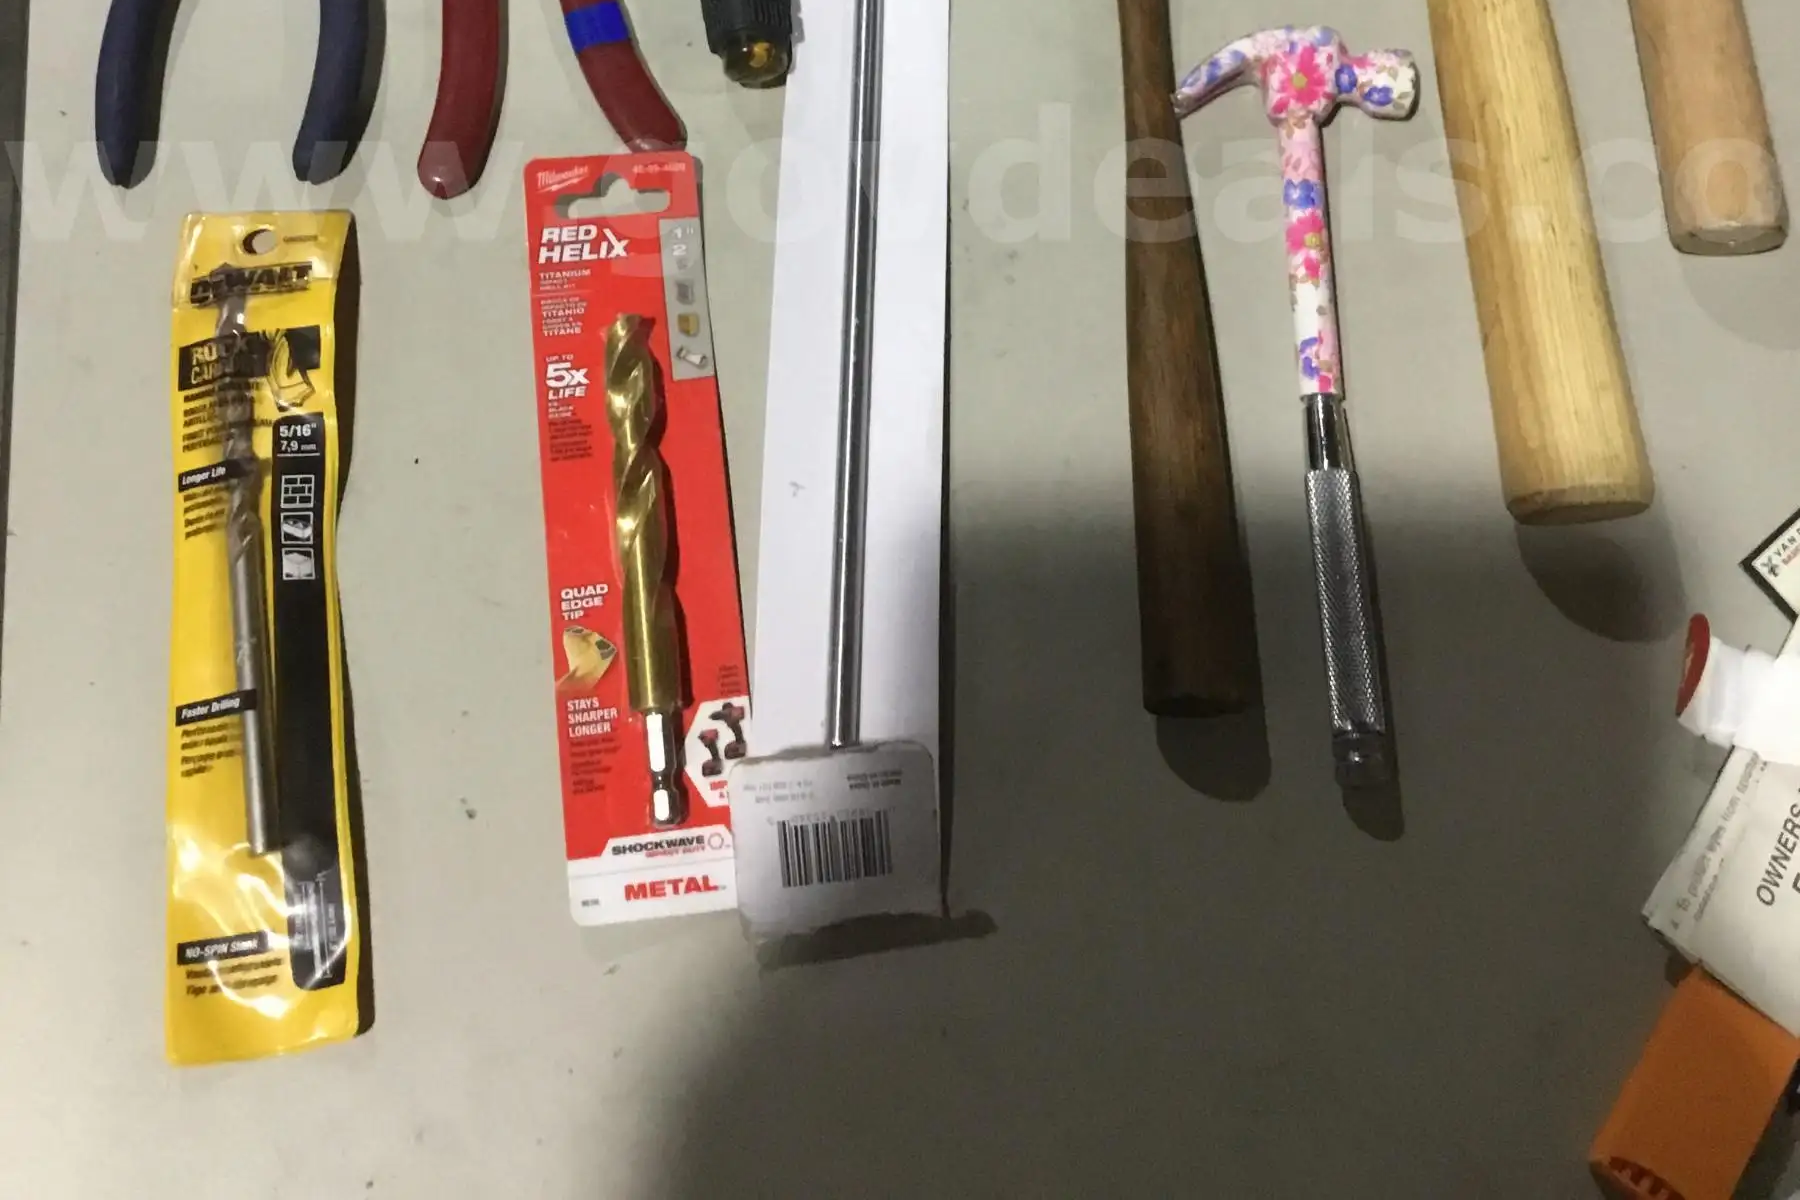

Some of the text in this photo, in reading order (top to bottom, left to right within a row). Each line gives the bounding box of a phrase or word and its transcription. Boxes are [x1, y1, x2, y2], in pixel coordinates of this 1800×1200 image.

[541, 225, 598, 244] RED
[538, 229, 630, 264] HELIX
[539, 269, 591, 279] TITANIUM
[543, 308, 585, 317] TITANIO
[548, 386, 587, 400] LIFE
[280, 423, 316, 437] 5/16"
[182, 466, 226, 485] Longer Life
[561, 584, 608, 600] QUAD
[561, 596, 604, 611] EDGE
[562, 610, 584, 620] TIP
[181, 698, 240, 719] Faster Drilling
[567, 697, 599, 711] STAYS
[567, 707, 618, 724] SHARPER
[568, 722, 611, 737] LONGER
[612, 835, 705, 855] SHOCKWAVE
[1756, 803, 1800, 907] OWNERS
[624, 875, 719, 900] METAL
